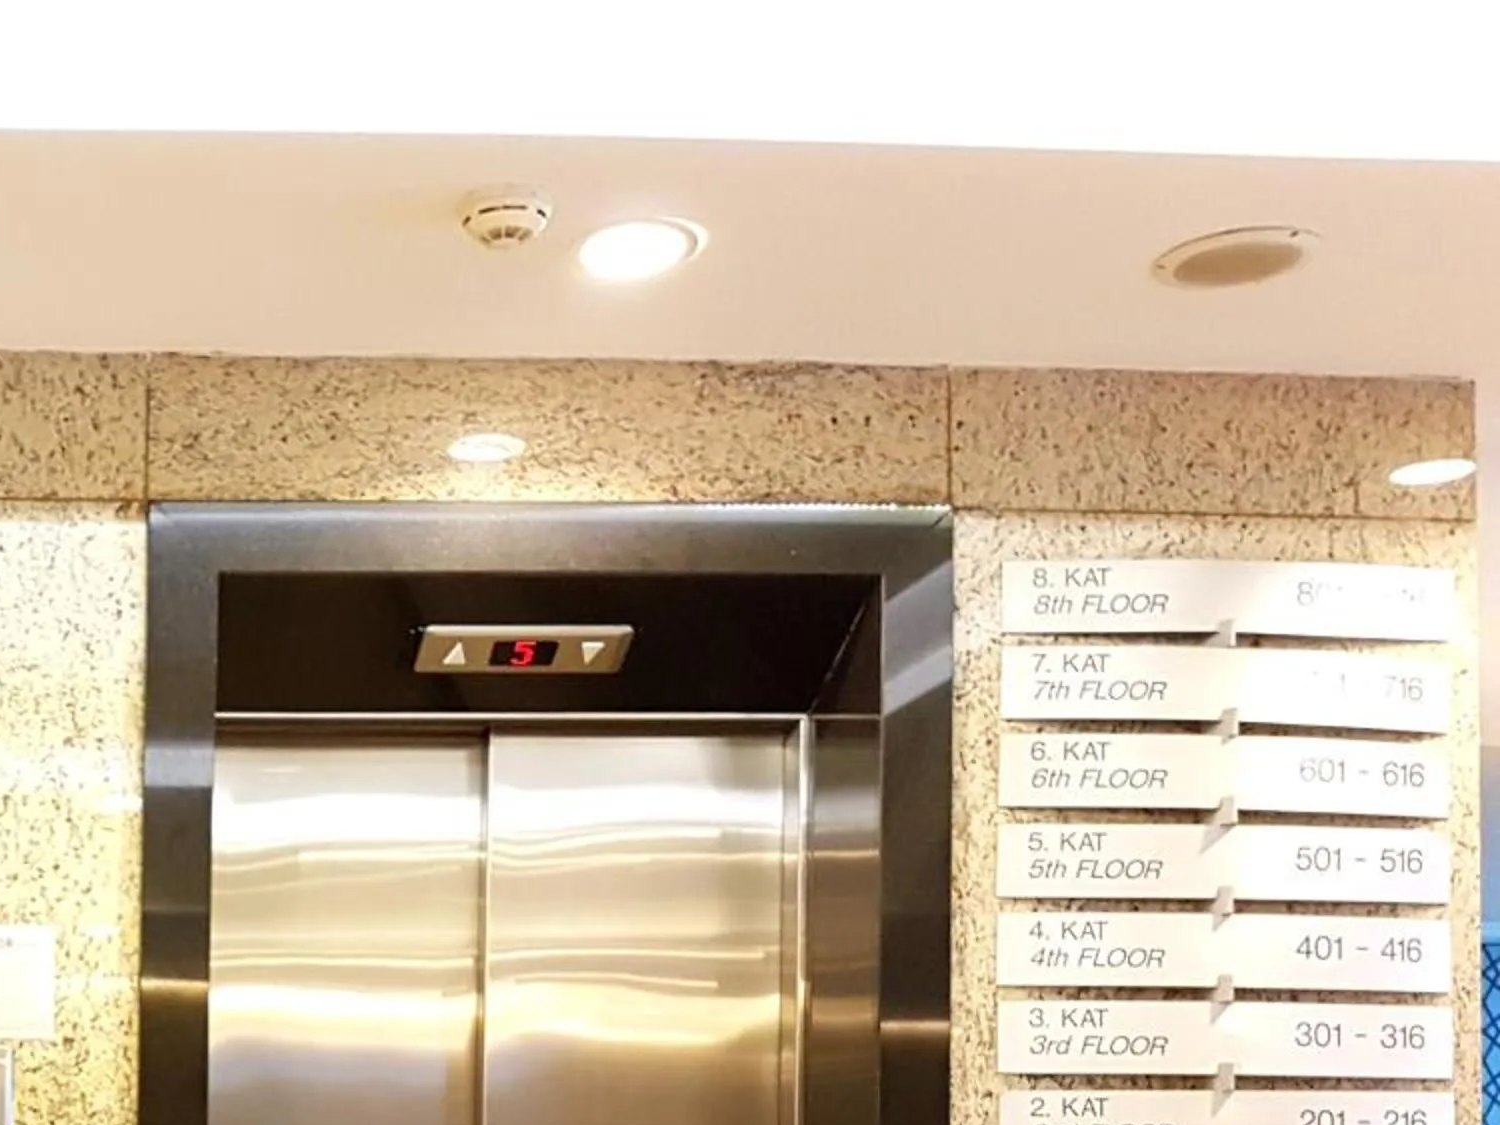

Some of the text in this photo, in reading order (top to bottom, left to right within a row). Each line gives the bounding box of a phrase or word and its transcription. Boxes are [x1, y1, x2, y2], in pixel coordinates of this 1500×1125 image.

[1033, 567, 1111, 588] 8. KAT
[1034, 594, 1169, 614] 8th FLOOR
[510, 641, 537, 667] 5
[1032, 653, 1110, 673] 7. KAT
[1034, 680, 1167, 700] 7th FLOOR
[1031, 740, 1110, 761] 6. KAT
[1032, 768, 1168, 789] 6th FLOOR
[1300, 759, 1345, 783] 601
[1383, 761, 1424, 787] 616
[1028, 832, 1106, 851] 5. KAT
[1028, 859, 1163, 879] 5th FLOOR
[1296, 847, 1341, 871] 501
[1380, 848, 1422, 874] 516
[1029, 920, 1108, 940] 4. KAT
[1031, 948, 1166, 968] 4th FLOOR
[1296, 936, 1342, 960] 401
[1381, 938, 1421, 963] 416
[1029, 1008, 1108, 1028] 3. KAT
[1030, 1035, 1168, 1056] 3rd FLOOR
[1295, 1022, 1341, 1048] 301
[1380, 1024, 1424, 1049] 316
[1030, 1097, 1108, 1117] 2. KAT
